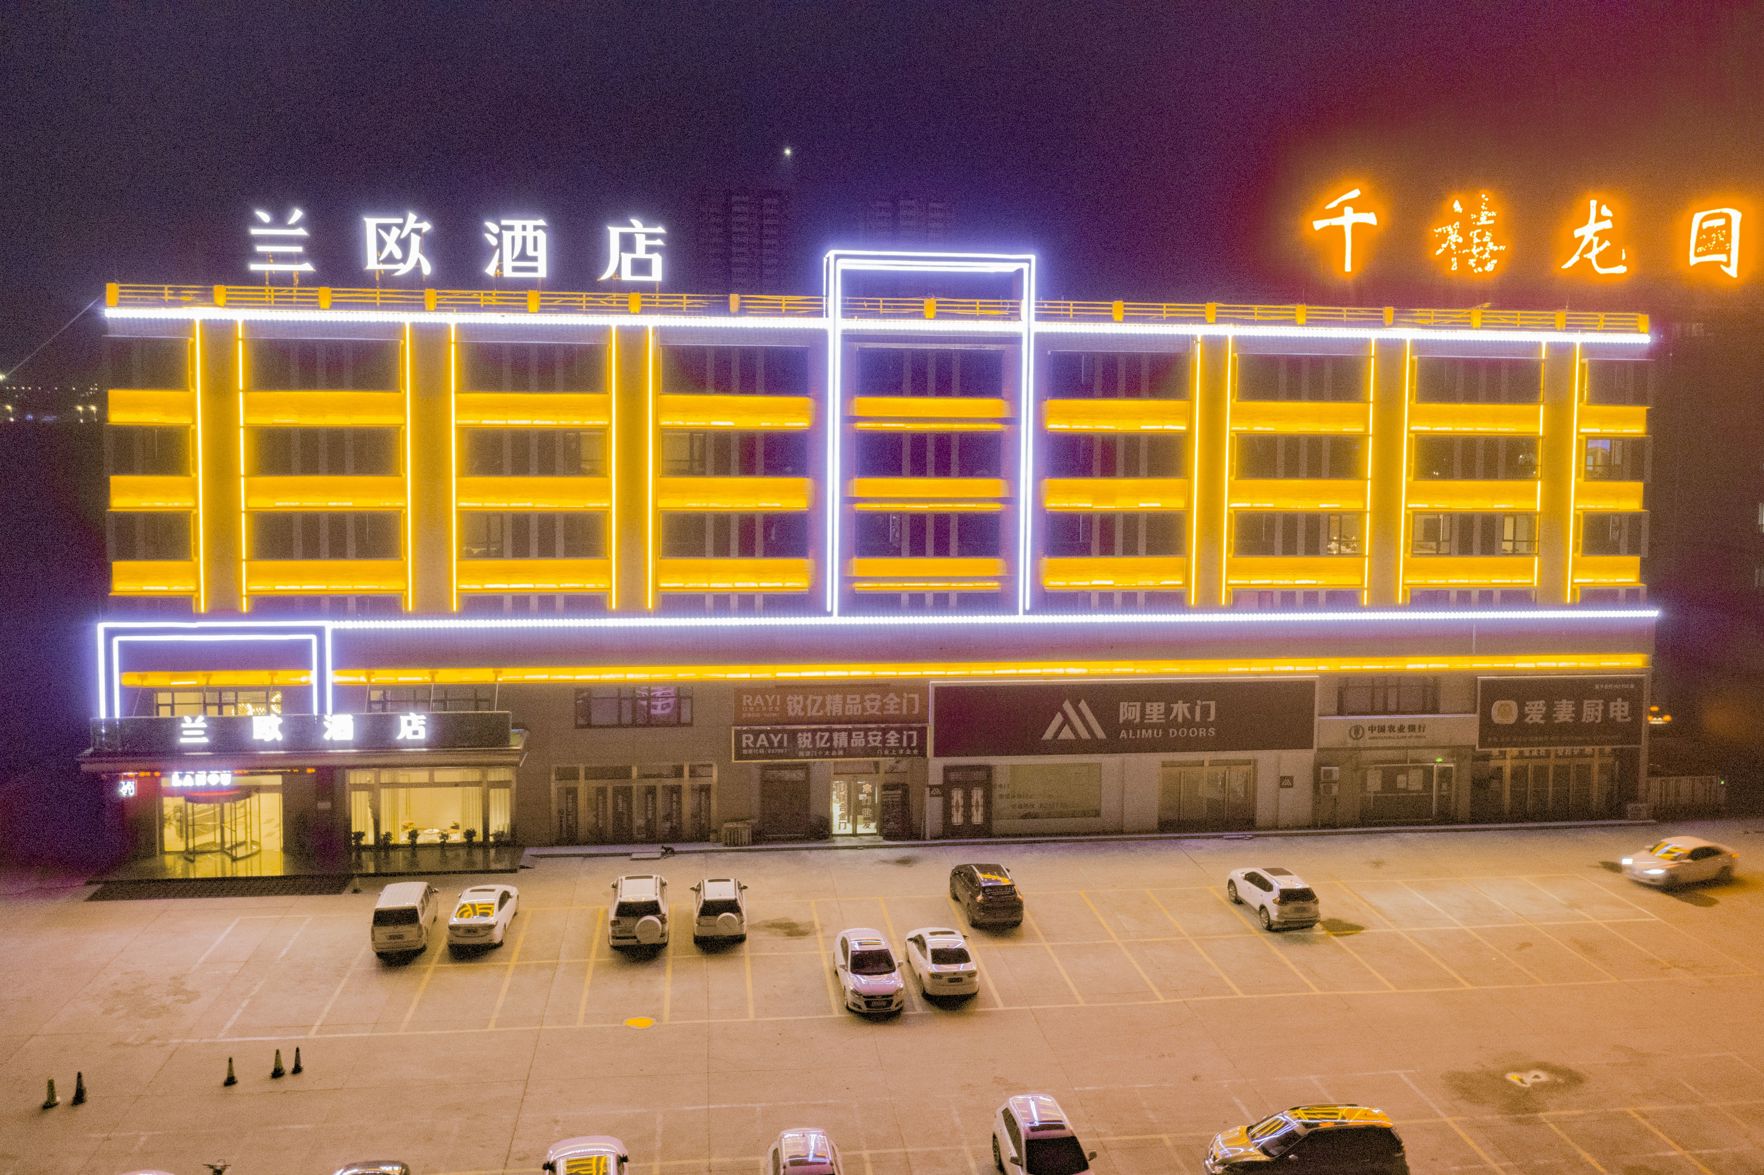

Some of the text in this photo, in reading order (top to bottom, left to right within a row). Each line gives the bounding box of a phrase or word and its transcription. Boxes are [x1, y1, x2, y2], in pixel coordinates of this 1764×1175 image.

[249, 208, 666, 282] 兰欧酒店
[742, 693, 920, 717] RAYI 锐亿精品安全门
[1119, 700, 1217, 724] 阿里木门
[1523, 698, 1632, 724] 爱妻厨电
[741, 730, 918, 748] RAYI 锐亿精品安全门
[1119, 726, 1217, 740] ALIMU DOORS
[1367, 724, 1426, 734] 中国农业银行
